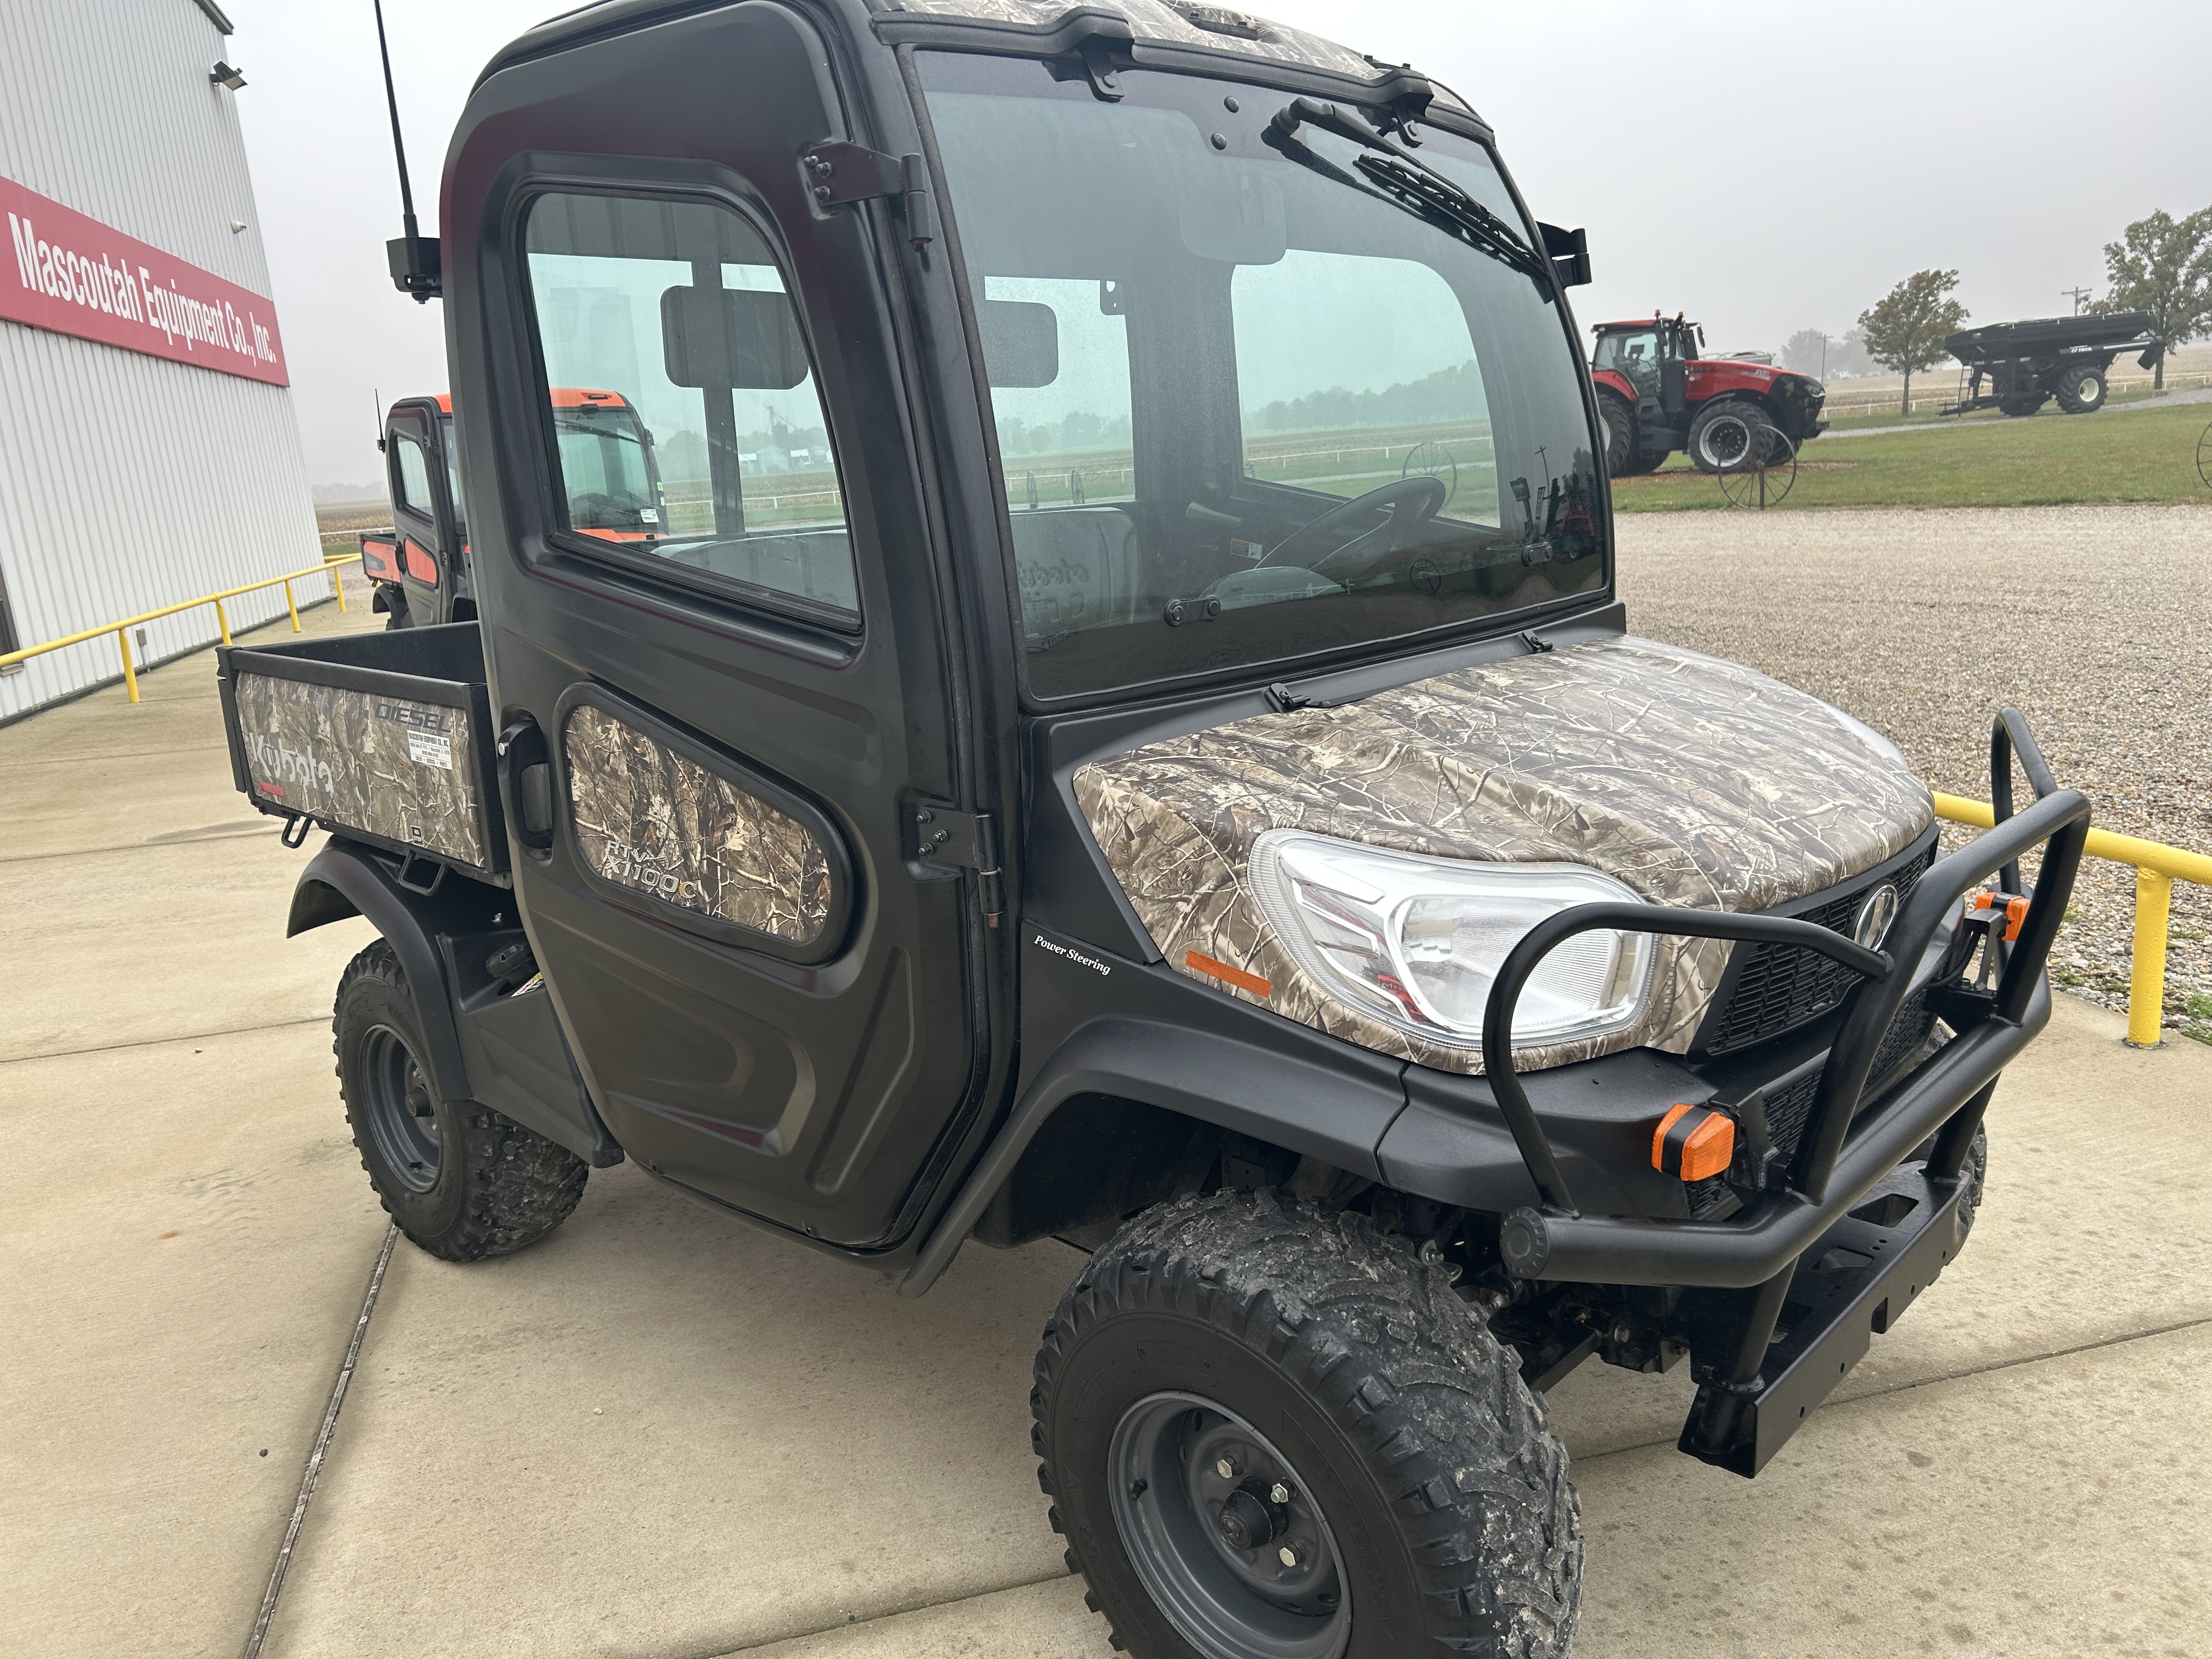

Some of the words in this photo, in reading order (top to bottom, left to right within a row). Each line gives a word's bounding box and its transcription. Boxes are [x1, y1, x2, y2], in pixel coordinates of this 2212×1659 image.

[8, 212, 144, 323] Mascoutah
[138, 266, 230, 351] Equipment
[225, 301, 256, 368] Co.,
[249, 311, 277, 363] Inc.
[375, 703, 452, 733] DIESEL
[249, 732, 334, 793] Kubota
[606, 839, 647, 863] RTV
[604, 854, 698, 899] X1100C
[1034, 934, 1067, 955] Power
[1066, 949, 1111, 976] Steering
